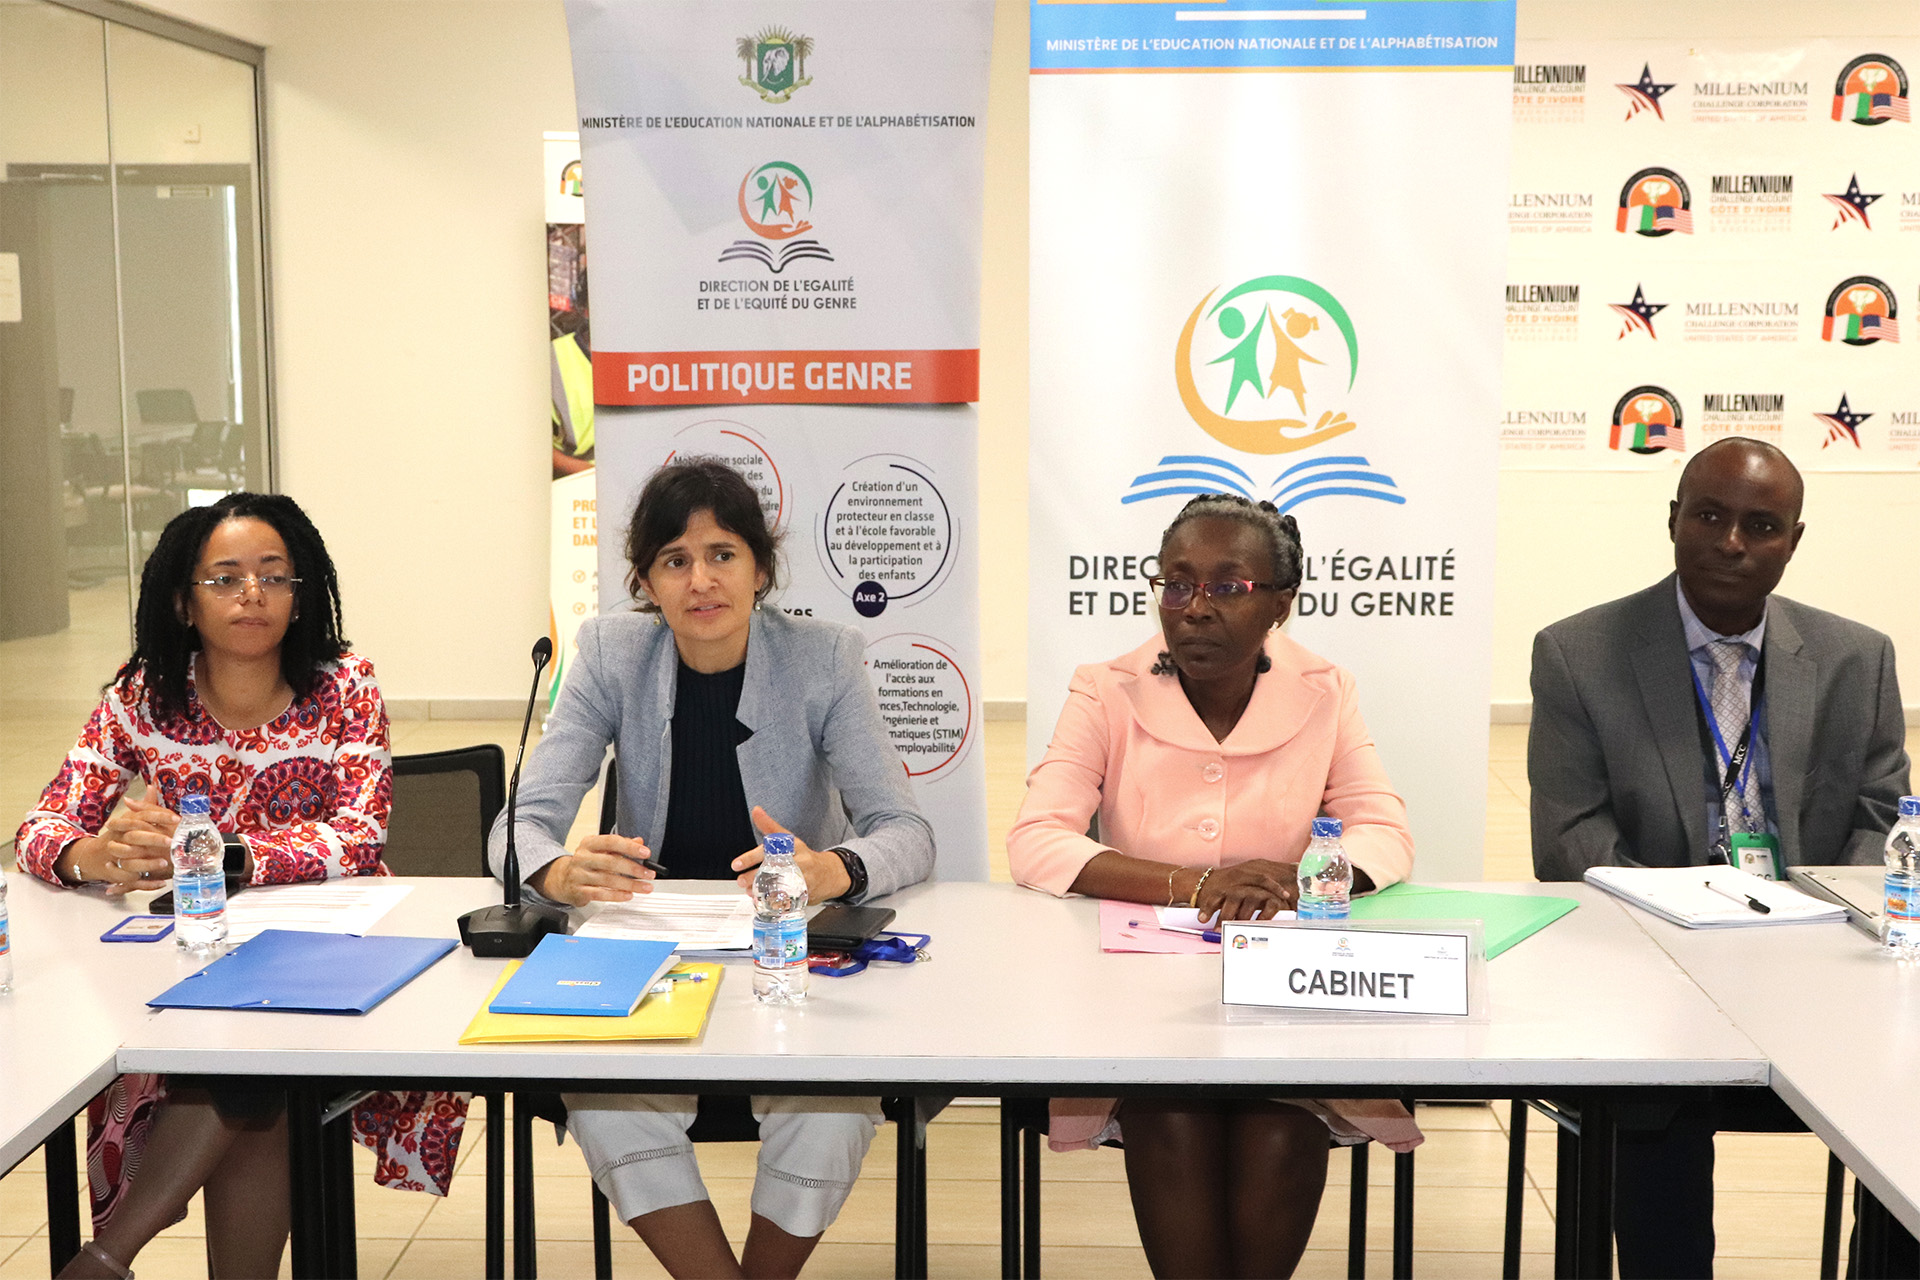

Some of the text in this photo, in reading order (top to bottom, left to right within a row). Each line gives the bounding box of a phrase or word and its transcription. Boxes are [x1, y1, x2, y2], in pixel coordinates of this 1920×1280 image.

[1046, 34, 1498, 51] MINISTÈRE DE L'EDUCATION NATIONALE ET DE L'ALPHABÉTISATION
[1514, 65, 1586, 83] ILLENNIUM
[1694, 82, 1808, 96] MILLENNIUM
[582, 113, 975, 128] MINISTÈRE DE L'EDUCATION NATIONALE ET DE L'ALPHABÉTISATION
[1712, 175, 1793, 193] MILLENNIUM
[1508, 194, 1593, 207] LENNIUM
[699, 276, 855, 292] DIRECTION DE L'EGALITÉ
[697, 295, 857, 310] ET DE L'EQUITÉ DU GENRE
[1685, 302, 1799, 316] MILLENNIUM
[1506, 313, 1526, 323] ÔTE
[628, 362, 912, 397] POLITIQUE GENRE
[1704, 394, 1784, 412] MILLENNIUM
[1501, 411, 1587, 425] LENNIUM
[1891, 412, 1920, 425] MIL
[732, 454, 763, 465] sociale
[747, 470, 764, 480] des
[761, 485, 773, 495] du
[852, 481, 918, 492] Création d'un
[573, 500, 597, 512] PRO
[760, 501, 780, 511] ndre
[848, 496, 923, 507] environnement
[573, 517, 597, 529] ET L
[836, 511, 935, 523] protecteur en classe
[835, 525, 936, 536] et à l'école favorable
[573, 534, 598, 546] DAN
[830, 540, 942, 552] au développement et à
[849, 554, 923, 567] la participation
[1069, 549, 1455, 581] DIREC L'ÉGALITÉ
[858, 570, 916, 580] des enfants
[856, 591, 885, 602] Axe 2
[1069, 591, 1454, 617] ET DE DU GENRE
[873, 659, 948, 670] Amélioration de
[886, 673, 935, 684] l'accès aux
[878, 687, 943, 698] formations en
[879, 701, 960, 714] nces,Technologie,
[930, 715, 939, 725] et
[889, 728, 964, 740] matiques (STIM)
[1733, 744, 1747, 765] MCC
[1288, 967, 1415, 999] CABINET
